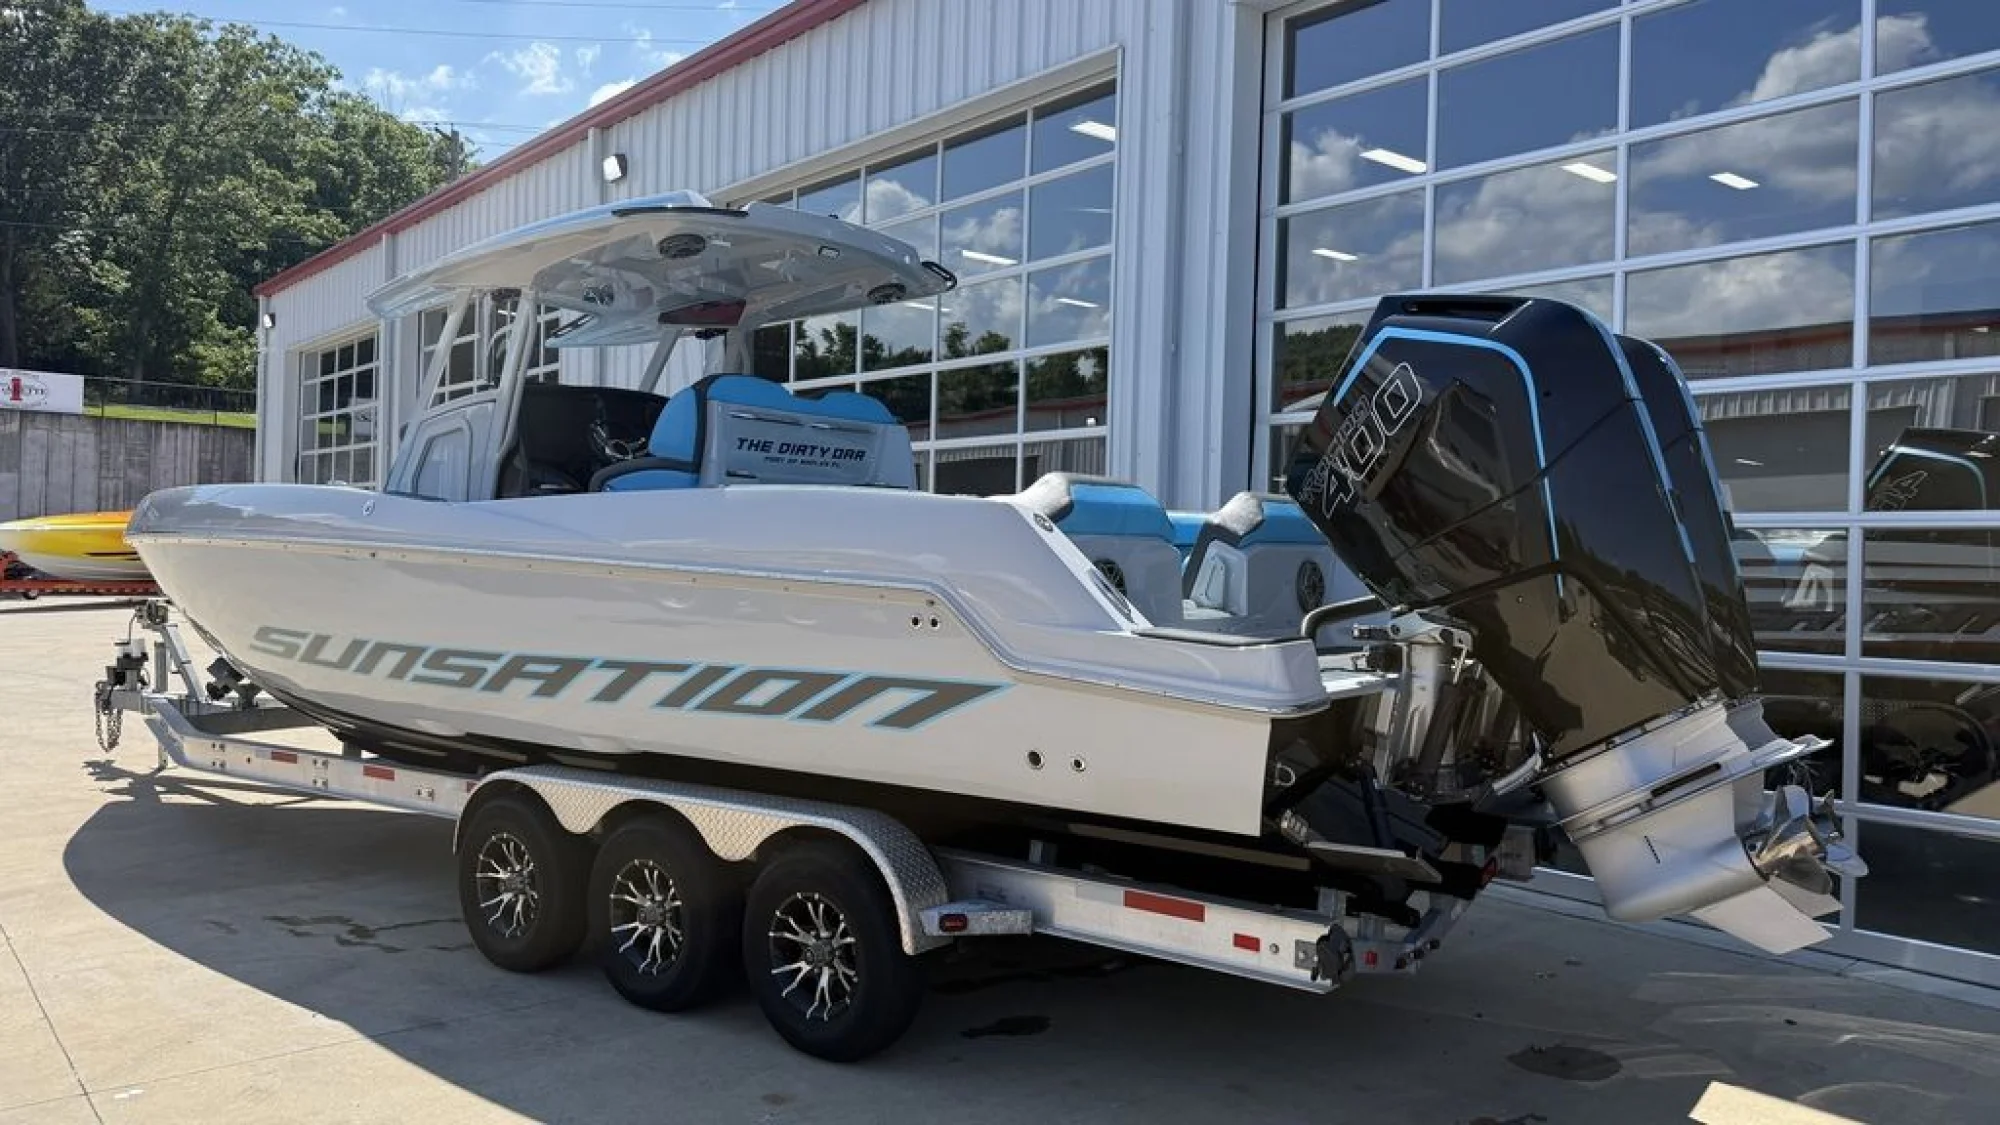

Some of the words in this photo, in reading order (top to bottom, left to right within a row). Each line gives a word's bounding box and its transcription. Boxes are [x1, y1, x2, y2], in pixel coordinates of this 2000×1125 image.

[736, 437, 774, 454] THE
[777, 442, 830, 458] DIRTY
[1322, 361, 1422, 519] 400
[249, 626, 1012, 732] SUNSATION
